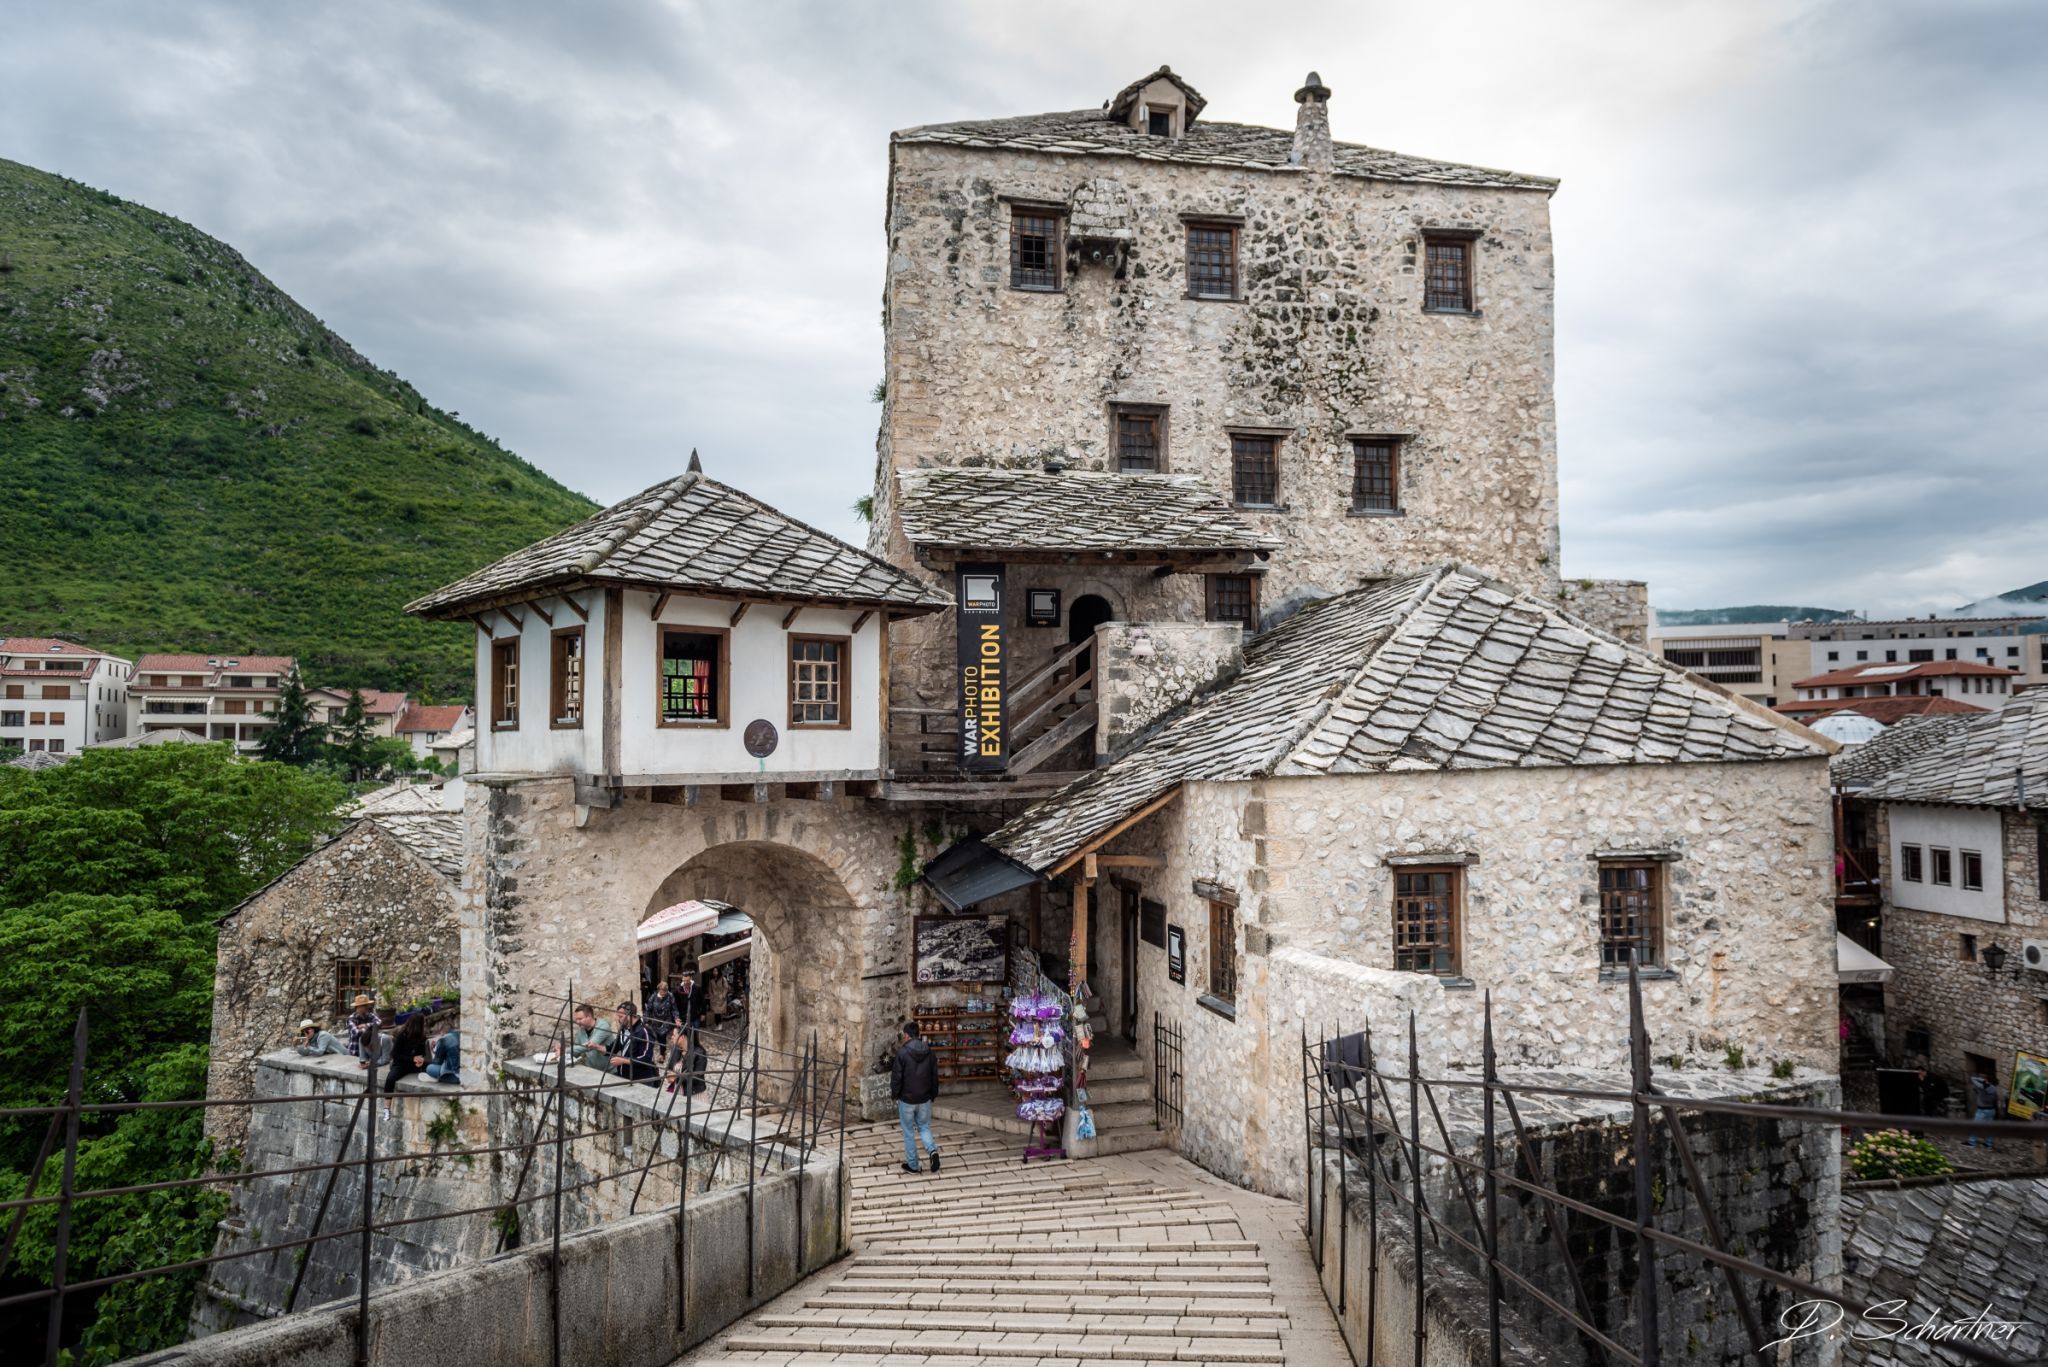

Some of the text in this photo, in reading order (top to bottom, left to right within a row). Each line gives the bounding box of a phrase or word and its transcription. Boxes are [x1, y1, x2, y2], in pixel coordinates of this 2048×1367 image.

[964, 665, 979, 756] WARPHOTO
[980, 624, 1000, 756] EXHIBITION
[871, 1087, 892, 1099] FOR
